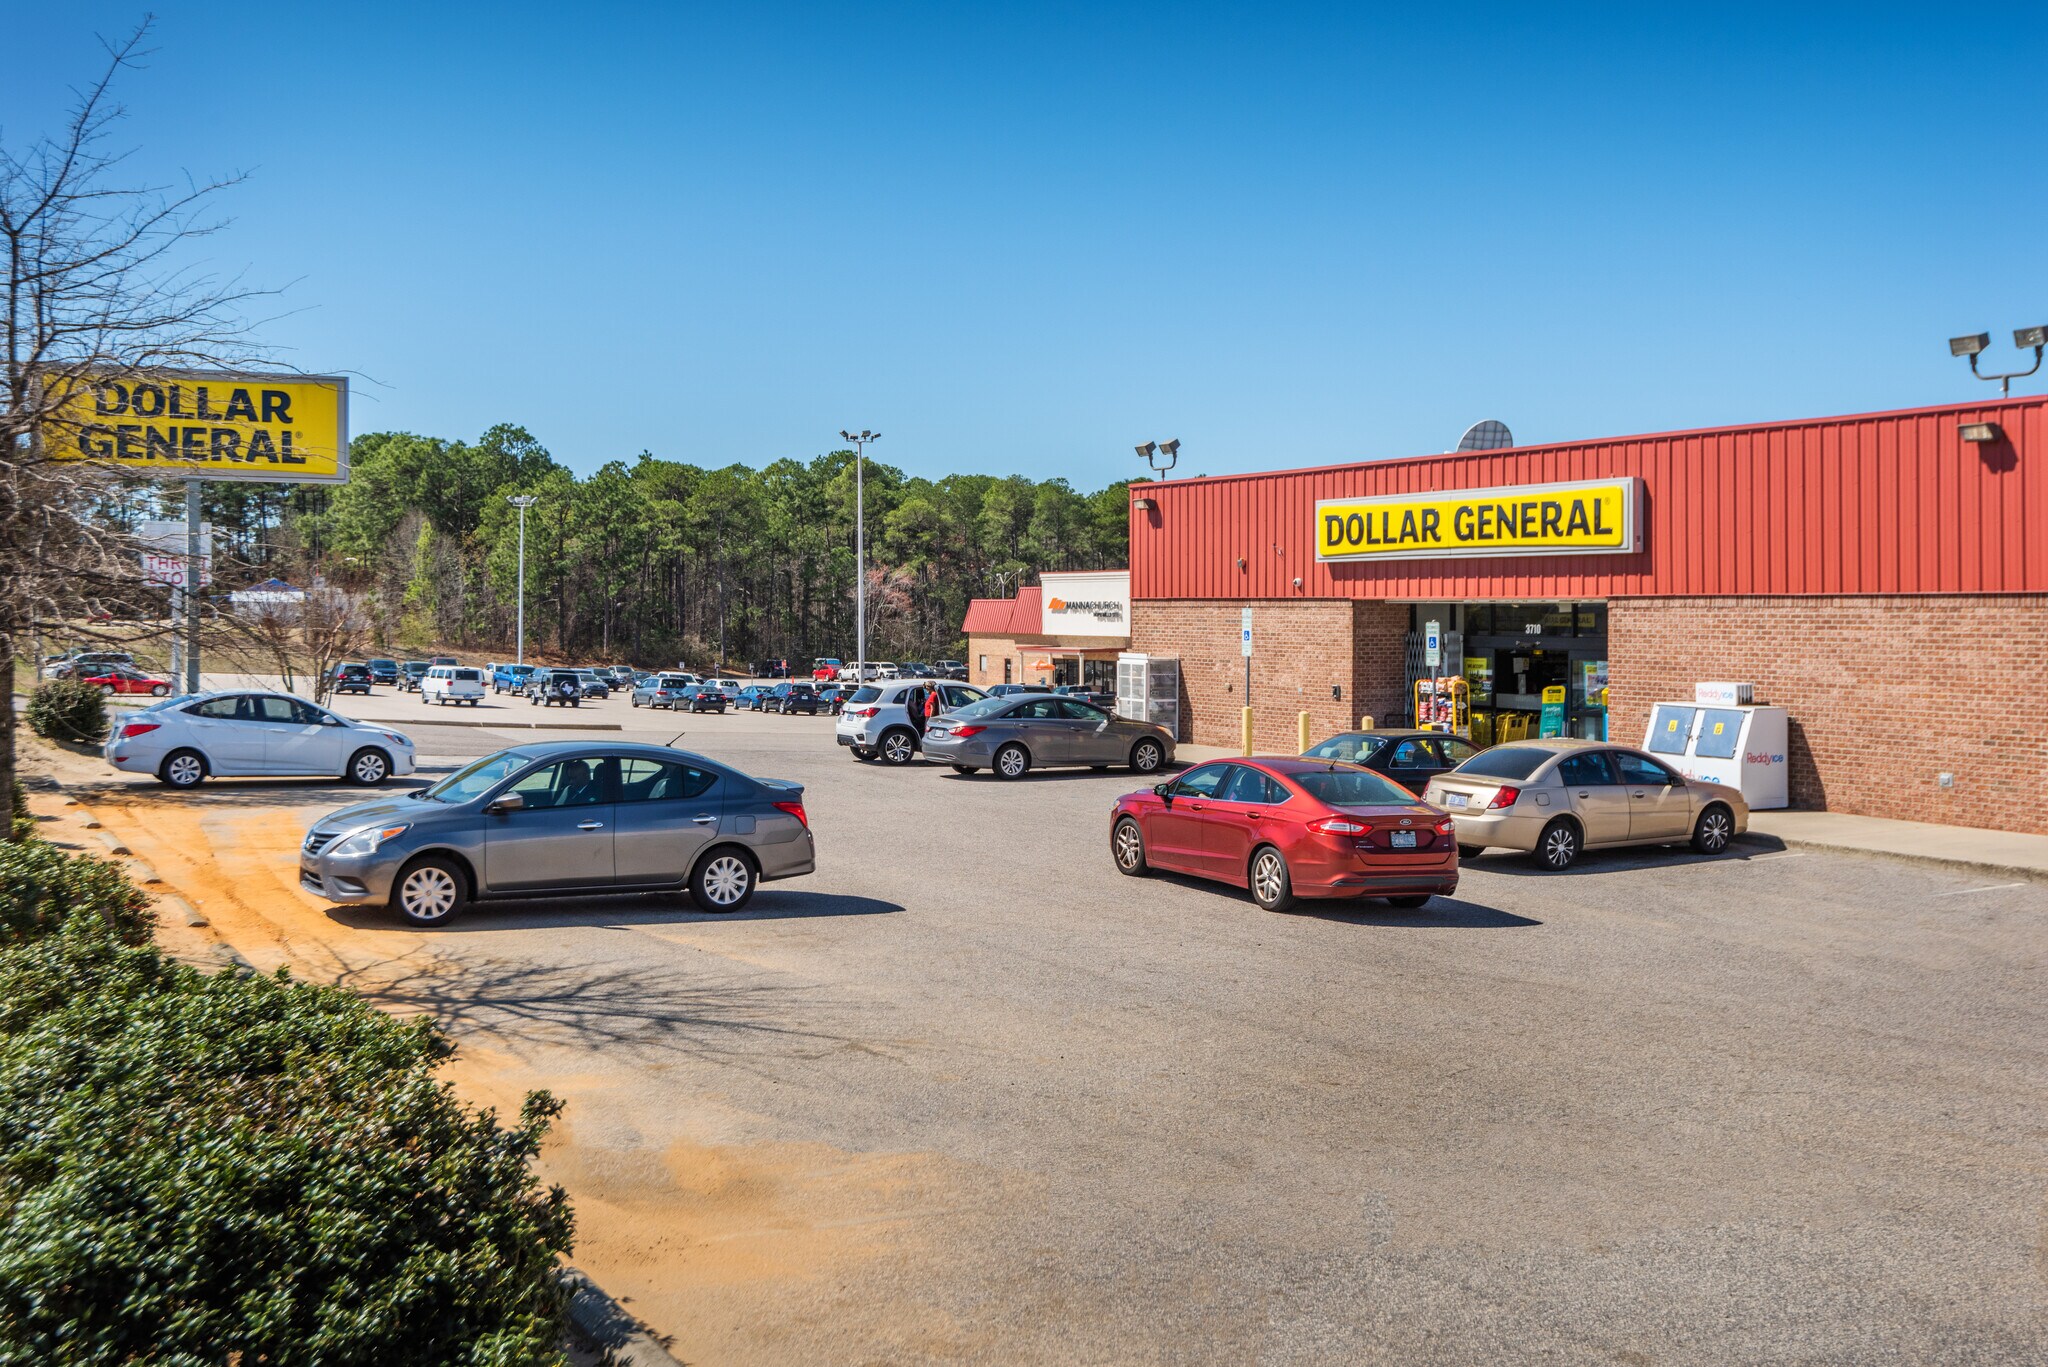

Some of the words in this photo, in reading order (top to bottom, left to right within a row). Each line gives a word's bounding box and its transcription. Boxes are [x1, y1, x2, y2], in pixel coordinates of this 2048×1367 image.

[96, 384, 294, 424] DOLLAR
[1325, 509, 1441, 547] DOLLAR
[1454, 497, 1613, 541] GENERAL
[1525, 624, 1541, 634] 3710
